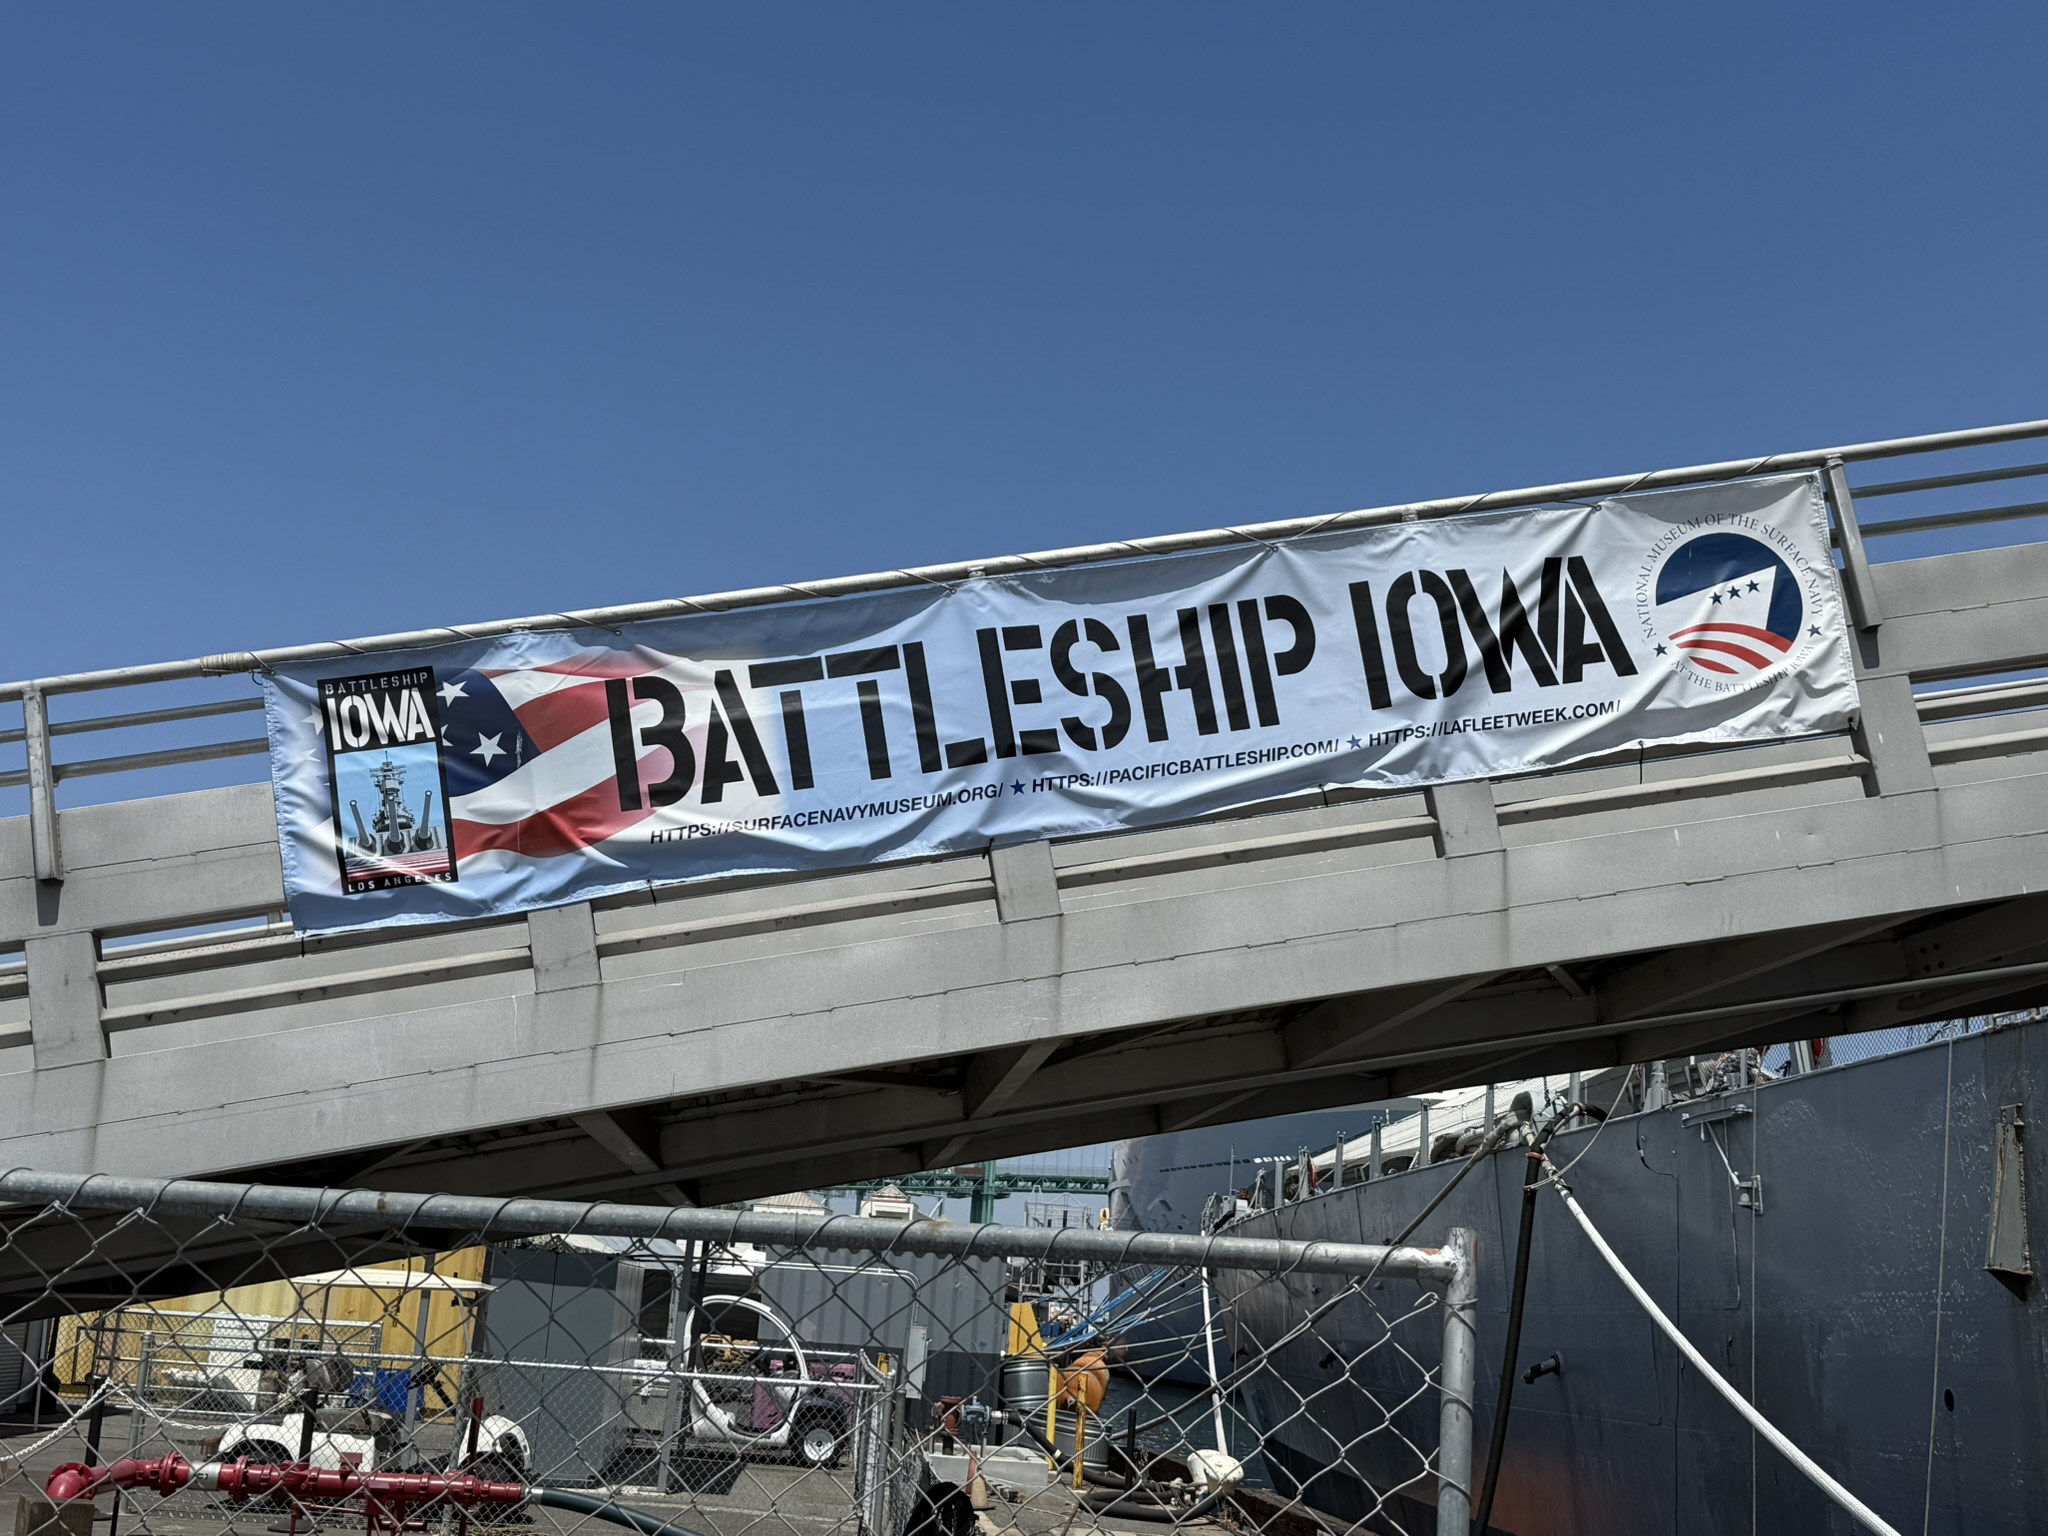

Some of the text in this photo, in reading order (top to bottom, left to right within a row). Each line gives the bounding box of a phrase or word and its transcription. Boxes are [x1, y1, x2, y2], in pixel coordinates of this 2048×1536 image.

[1636, 512, 1824, 639] NATIONAL MUSEUM OF THE SURFACE NAVY
[325, 671, 429, 696] BATTLESHIP
[605, 556, 1638, 811] BATTLESHIP IOWA
[1670, 660, 1688, 674] AT
[1688, 671, 1712, 690] THE
[326, 687, 437, 750] IOWA
[650, 699, 1621, 845] HTTPS://SURFACENAVYMUSEUM.ORG/ HTTPS://PACIFICBATTLESHIP.COM/ HTTPS://LAFLEETWEEK.COM/
[348, 872, 452, 893] LOS ANGELES
